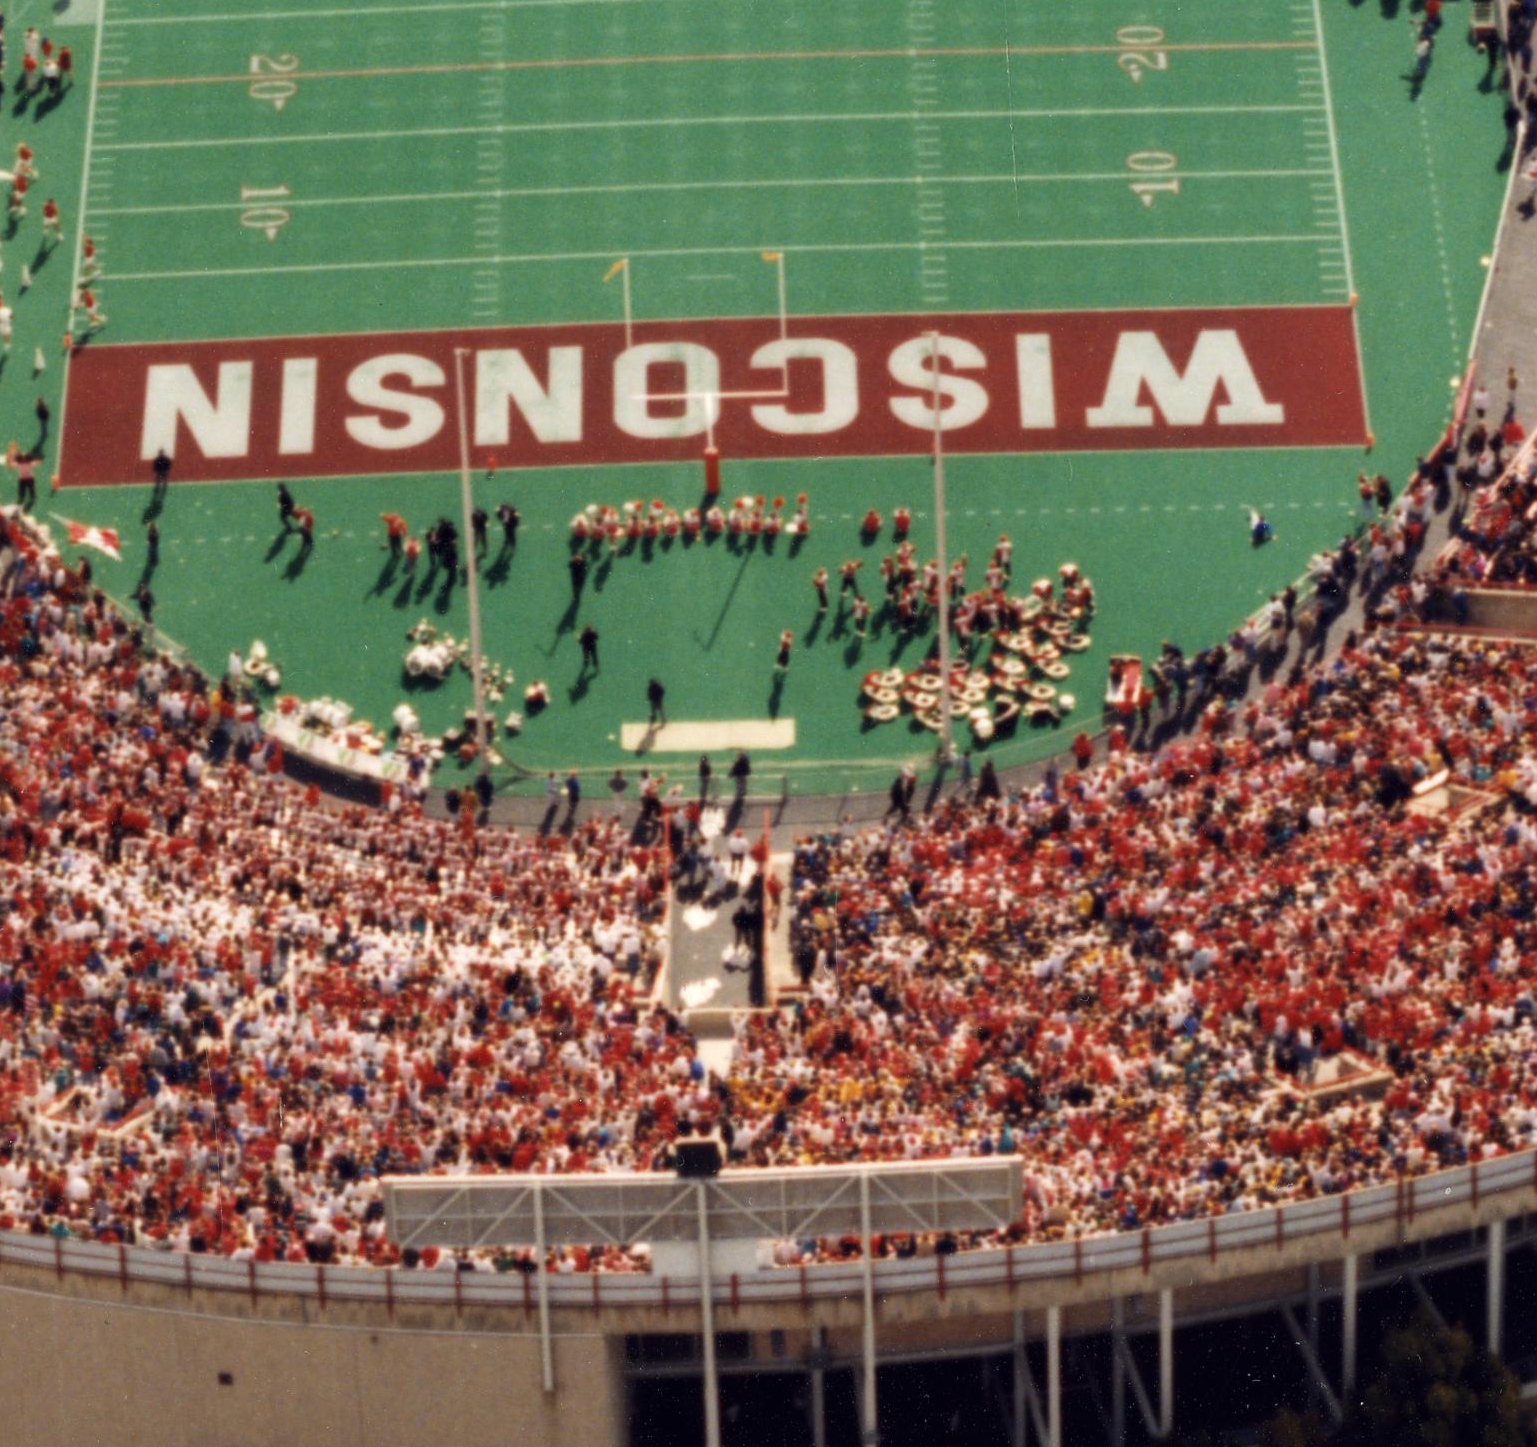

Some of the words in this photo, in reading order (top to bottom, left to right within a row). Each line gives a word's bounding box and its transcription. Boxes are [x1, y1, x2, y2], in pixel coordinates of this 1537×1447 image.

[1116, 25, 1169, 72] 20
[248, 53, 298, 100] 20
[1126, 151, 1179, 195] 10
[240, 185, 291, 228] 10
[140, 329, 1285, 459] WISCONSIN
